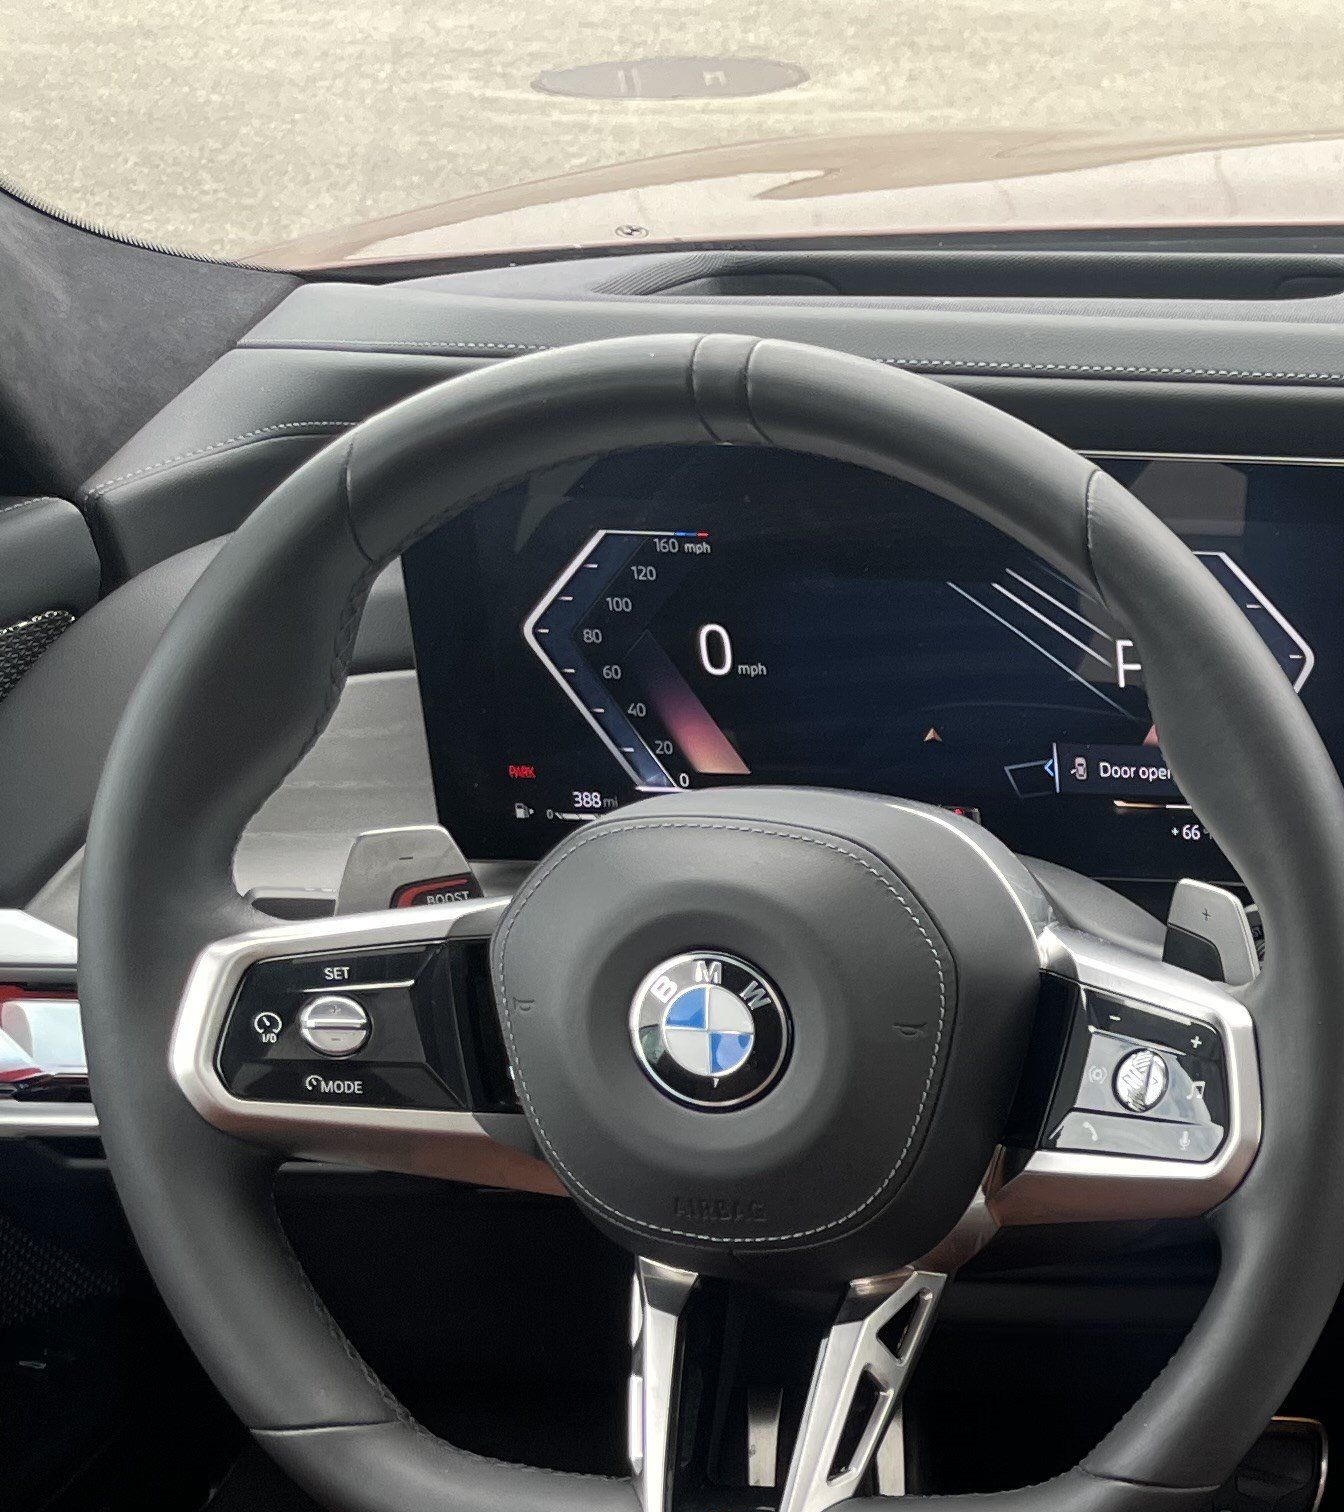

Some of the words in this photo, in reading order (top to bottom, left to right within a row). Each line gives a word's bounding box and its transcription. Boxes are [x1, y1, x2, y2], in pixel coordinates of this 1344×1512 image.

[653, 538, 679, 553] 160
[684, 542, 711, 554] mph
[631, 566, 657, 581] 120
[606, 597, 632, 612] 100
[583, 629, 603, 644] 80
[699, 623, 733, 676] 0
[738, 663, 767, 678] mph
[602, 665, 622, 680] 60
[627, 703, 646, 718] 40
[655, 740, 673, 755] 20
[1099, 761, 1136, 779] Door
[679, 773, 690, 789] 0
[572, 791, 602, 808] 388
[602, 796, 618, 808] mi
[426, 890, 470, 905] BOOST
[324, 966, 350, 980] SET
[650, 960, 772, 1011] BMW
[321, 1081, 364, 1094] MODE
